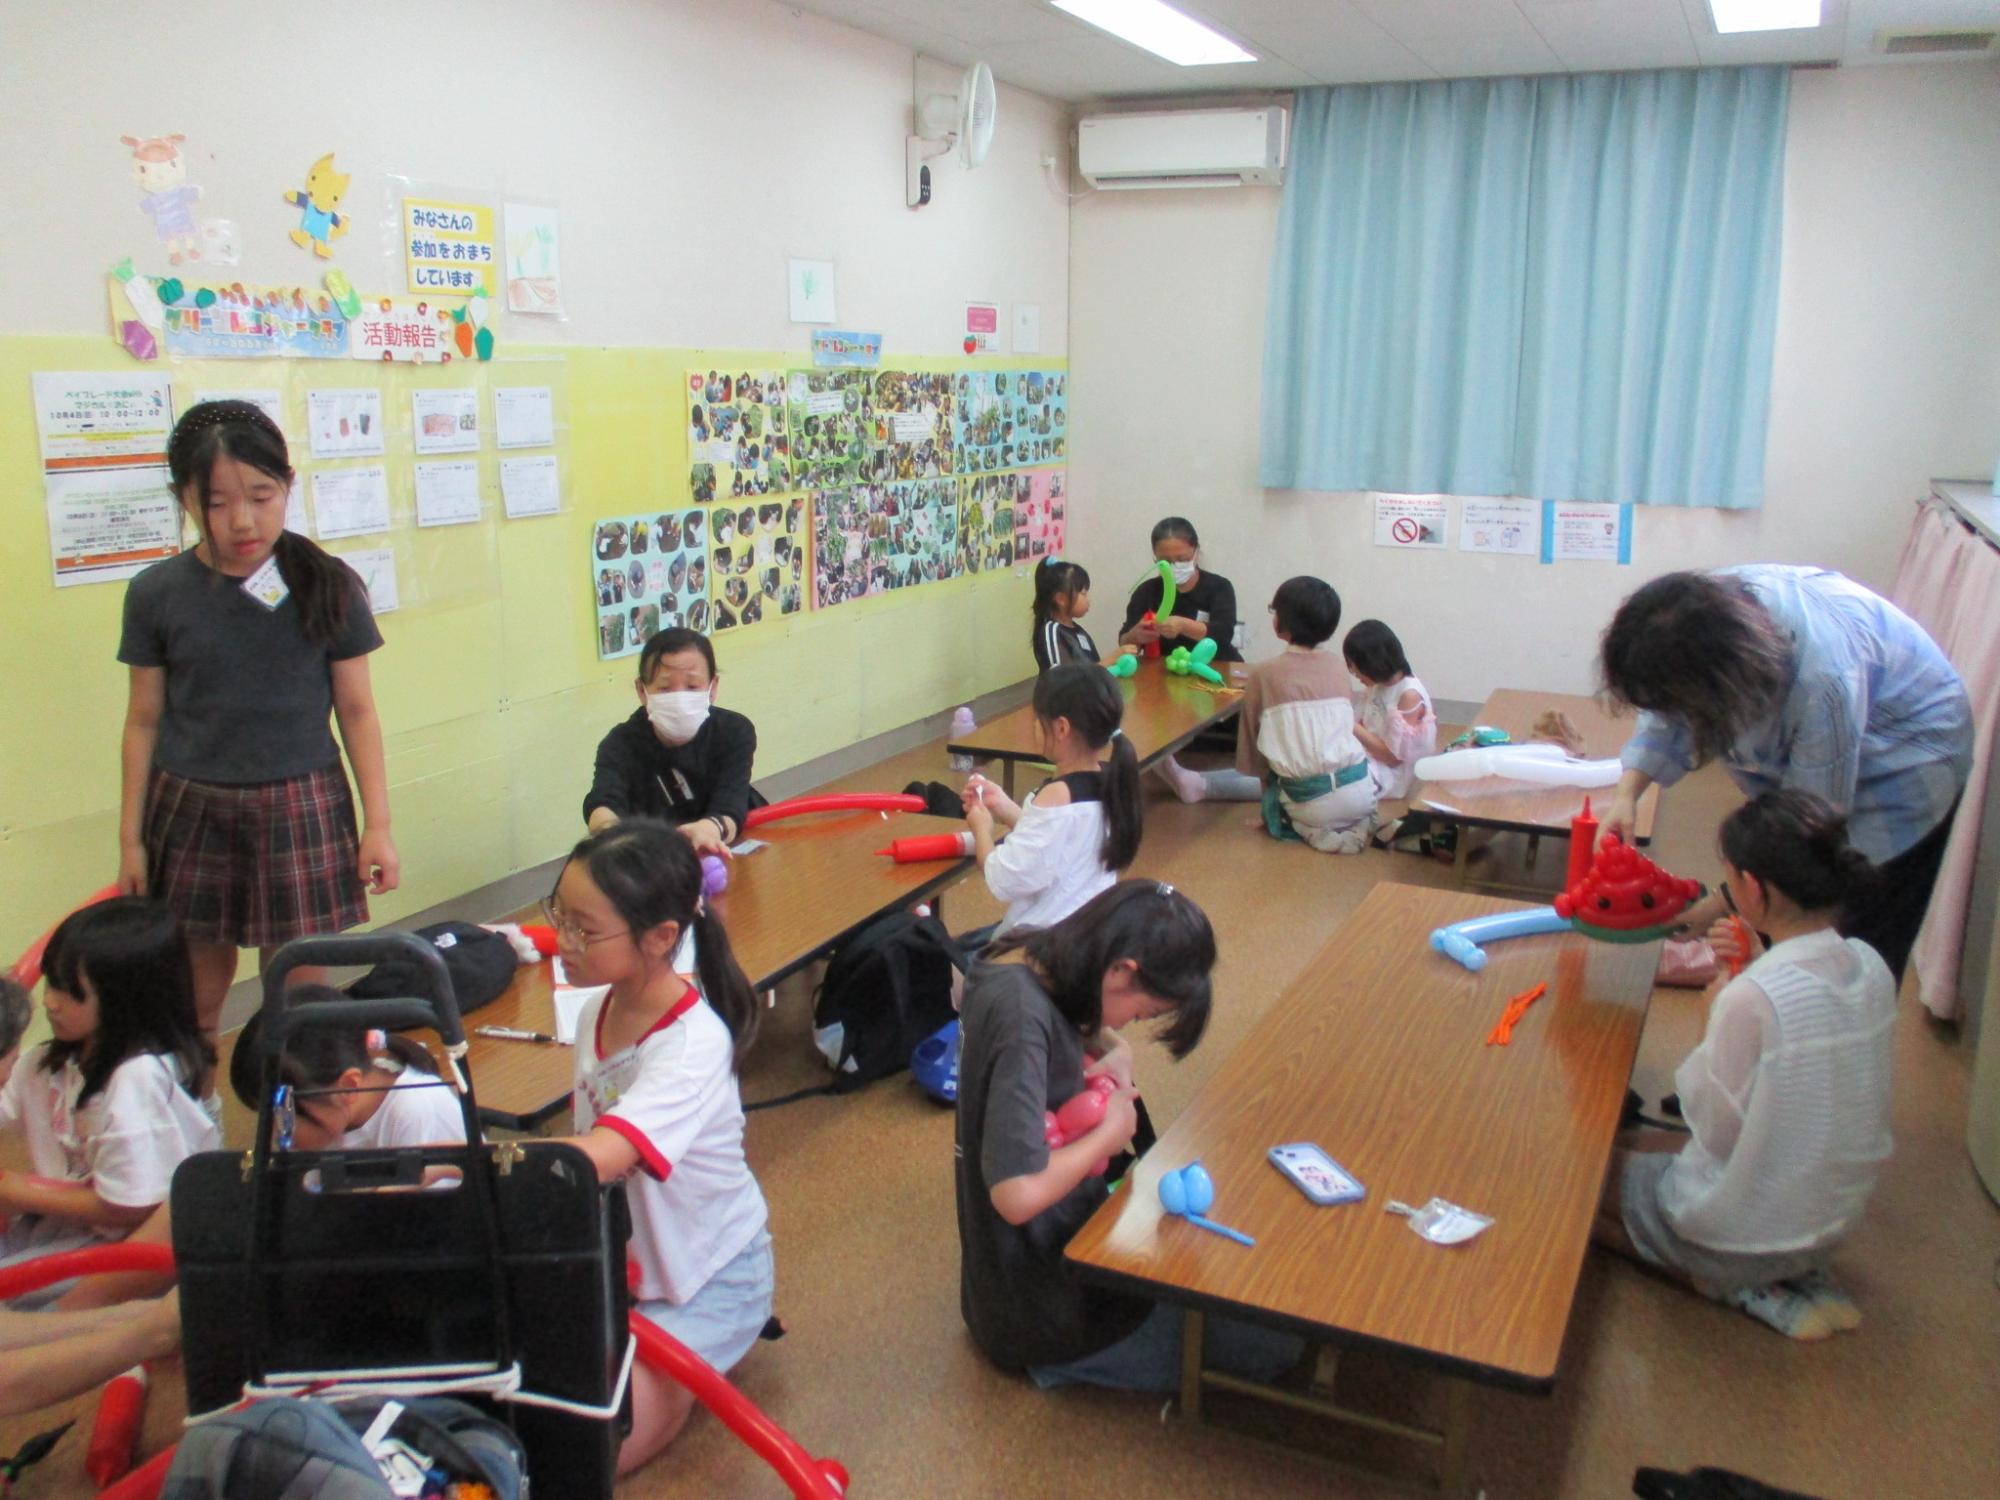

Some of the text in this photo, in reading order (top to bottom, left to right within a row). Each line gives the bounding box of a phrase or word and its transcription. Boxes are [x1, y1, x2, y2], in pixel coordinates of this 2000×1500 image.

[413, 209, 473, 231] みなさんの
[411, 239, 491, 261] 参加をおまち
[416, 268, 473, 287] しています
[363, 322, 437, 348] 活動報告
